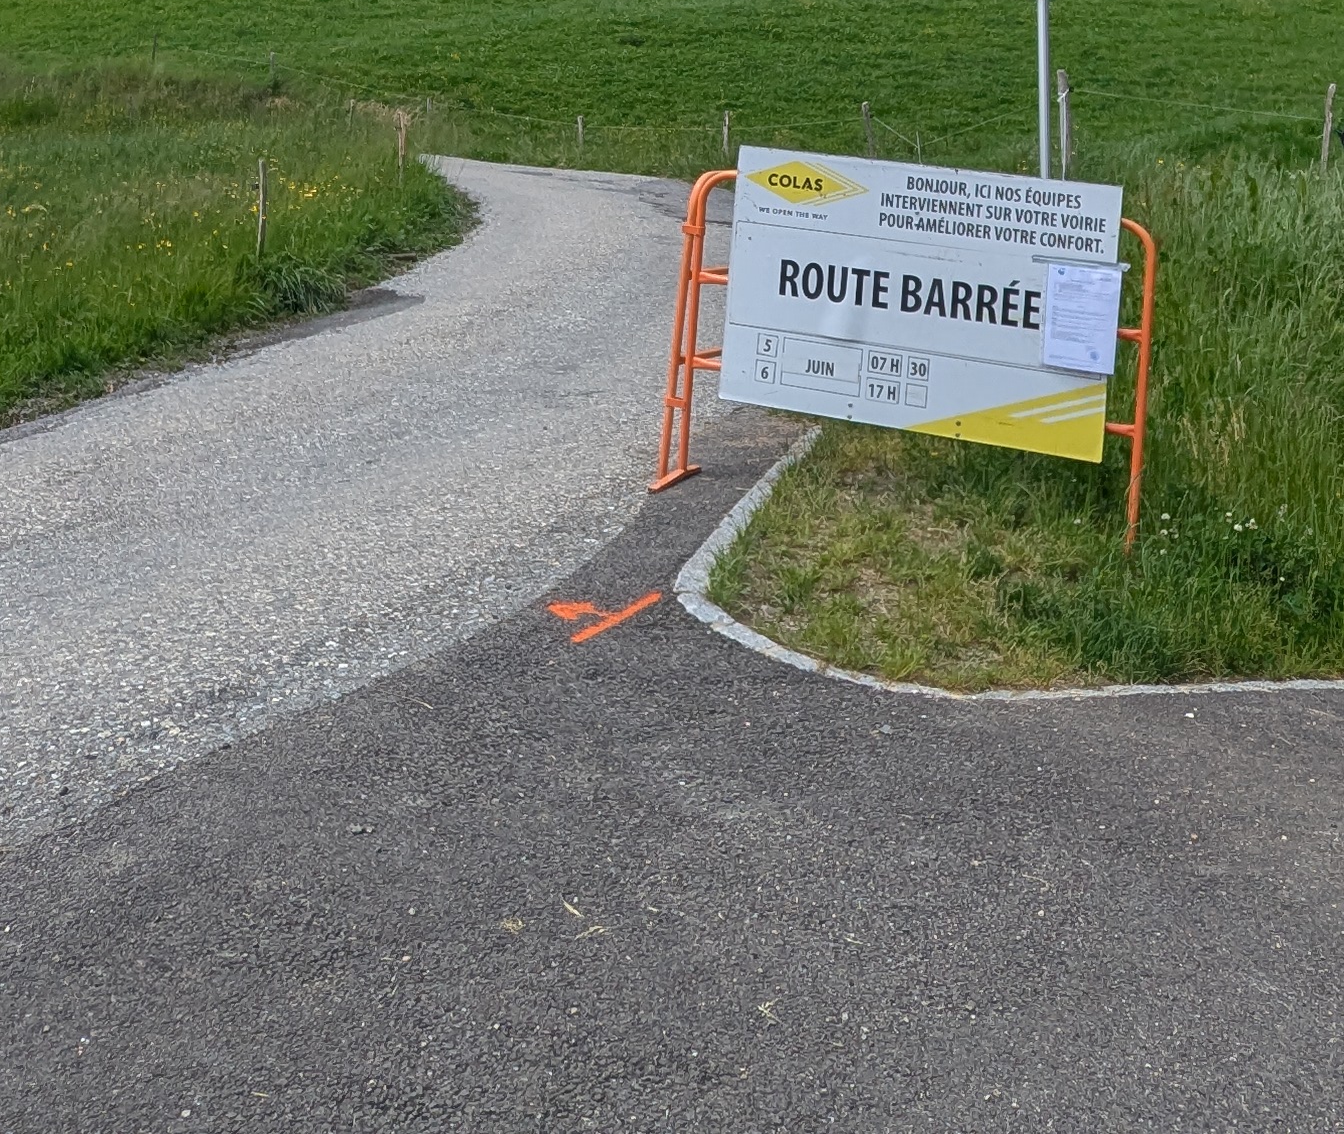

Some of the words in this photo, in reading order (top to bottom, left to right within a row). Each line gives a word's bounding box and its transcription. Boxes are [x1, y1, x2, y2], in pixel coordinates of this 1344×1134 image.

[768, 173, 823, 192] COLAS
[906, 176, 971, 200] BONJOUR,
[975, 183, 991, 200] ICI
[995, 186, 1022, 203] NOS
[1025, 187, 1081, 210] ÉQUIPES
[758, 206, 770, 214] WE
[772, 208, 793, 217] OPEN
[796, 211, 810, 219] THE
[812, 213, 828, 221] WAY
[880, 192, 983, 219] INTERVIENNENT
[985, 205, 1012, 222] SUR
[1015, 208, 1058, 227] VOTRE
[1061, 214, 1107, 233] VOIRIE
[879, 212, 914, 230] POUR
[915, 217, 991, 240] AMÉLIORER
[994, 226, 1037, 245] VOTRE
[1039, 232, 1105, 254] CONFORT.
[778, 259, 890, 309] ROUTE
[900, 274, 1042, 331] BARRÉE
[762, 339, 773, 352] 5
[760, 366, 769, 380] 6
[805, 359, 835, 377] JUIN
[870, 356, 888, 371] 07
[889, 359, 900, 374] H
[909, 362, 927, 377] 30
[868, 383, 885, 399] 17
[887, 386, 897, 401] H
